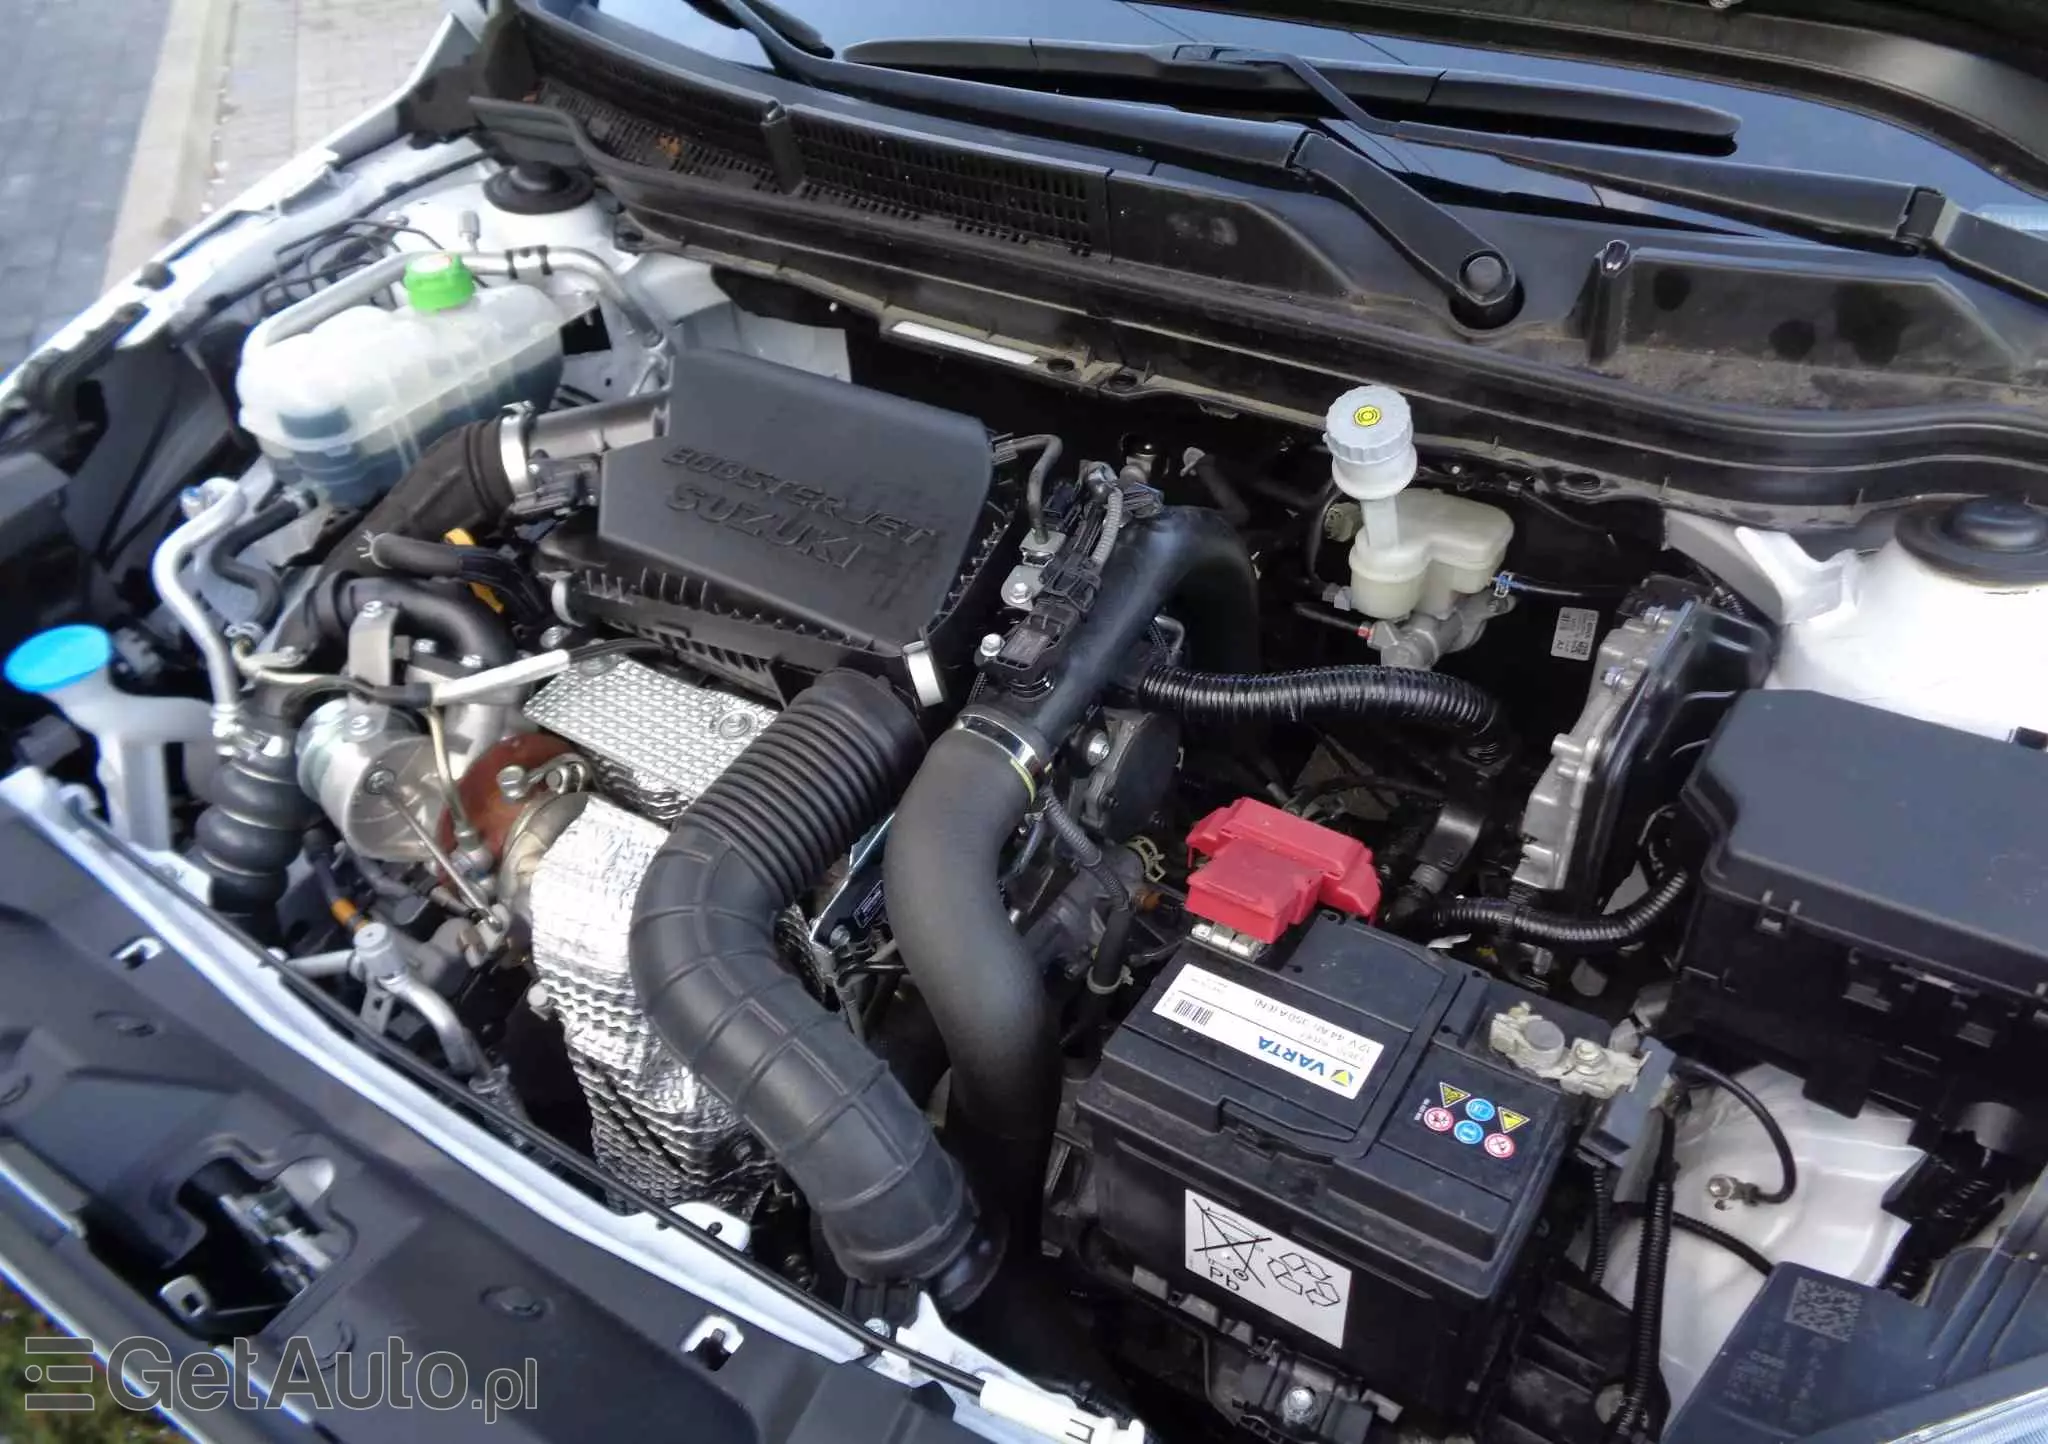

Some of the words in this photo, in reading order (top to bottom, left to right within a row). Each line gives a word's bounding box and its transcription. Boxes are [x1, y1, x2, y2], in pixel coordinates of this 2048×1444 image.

[662, 447, 936, 545] BOOSTERJET
[667, 483, 863, 569] SUZUKI
[1257, 1035, 1325, 1076] VARTA
[1209, 1267, 1240, 1291] Pb
